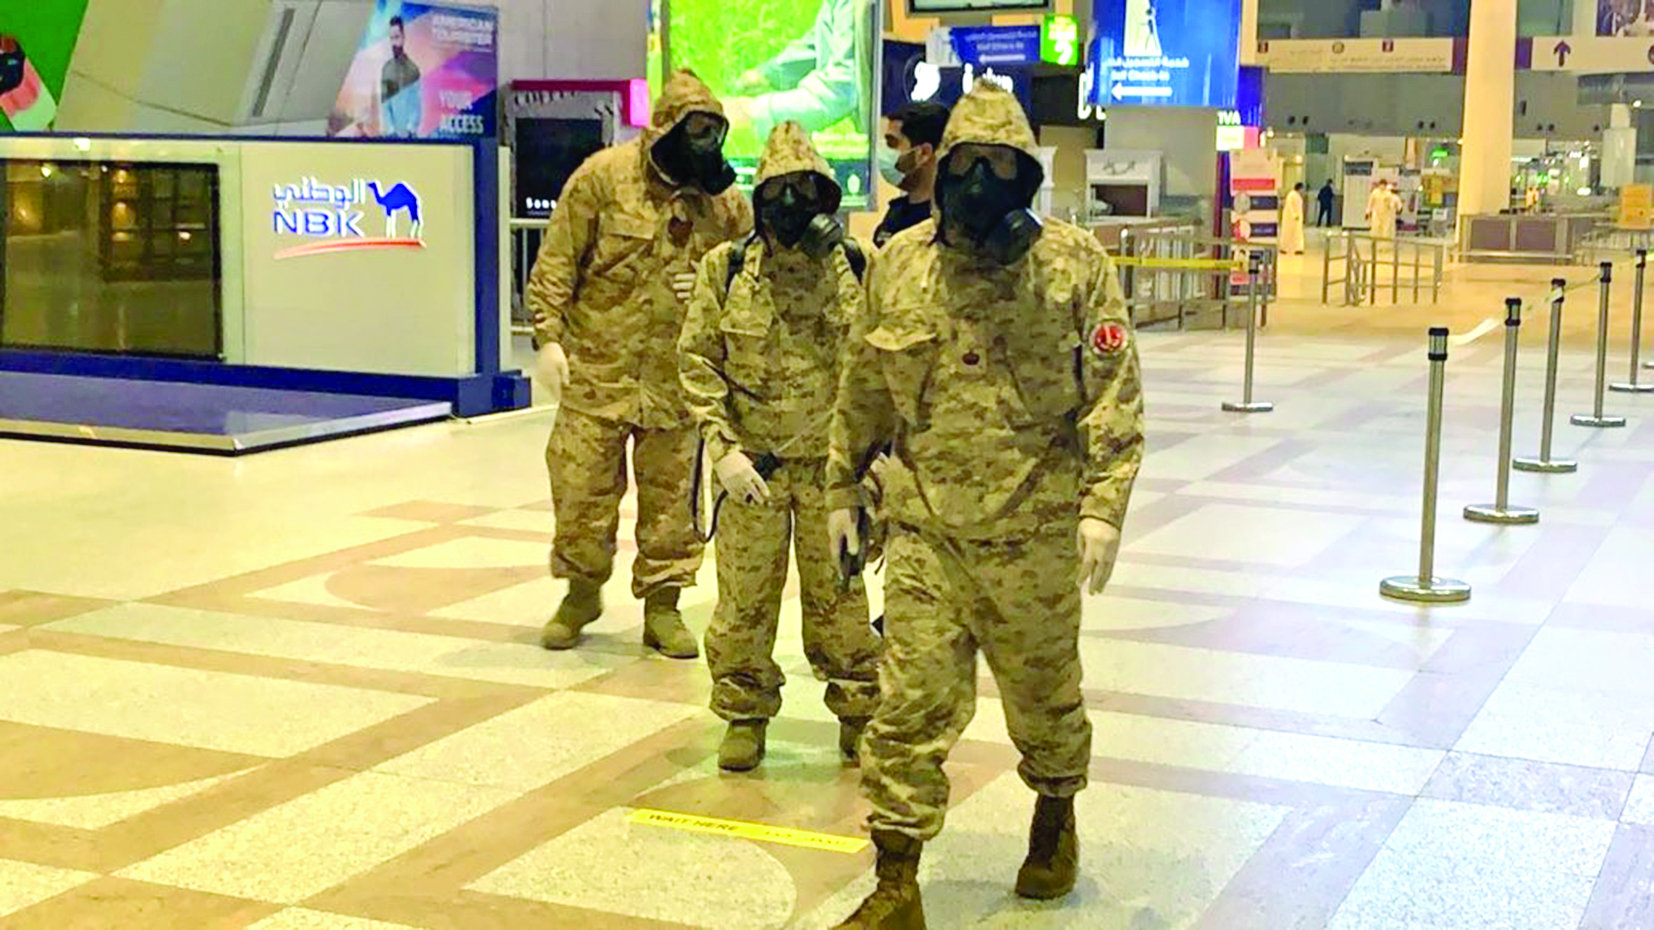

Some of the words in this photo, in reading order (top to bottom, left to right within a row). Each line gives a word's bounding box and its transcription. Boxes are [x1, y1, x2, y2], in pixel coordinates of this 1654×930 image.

[439, 89, 473, 110] YOUR
[439, 113, 484, 134] ACCESS
[273, 176, 365, 211] الوطني
[273, 208, 365, 238] NBK
[648, 813, 691, 825] WAIT
[692, 819, 740, 832] HERE
